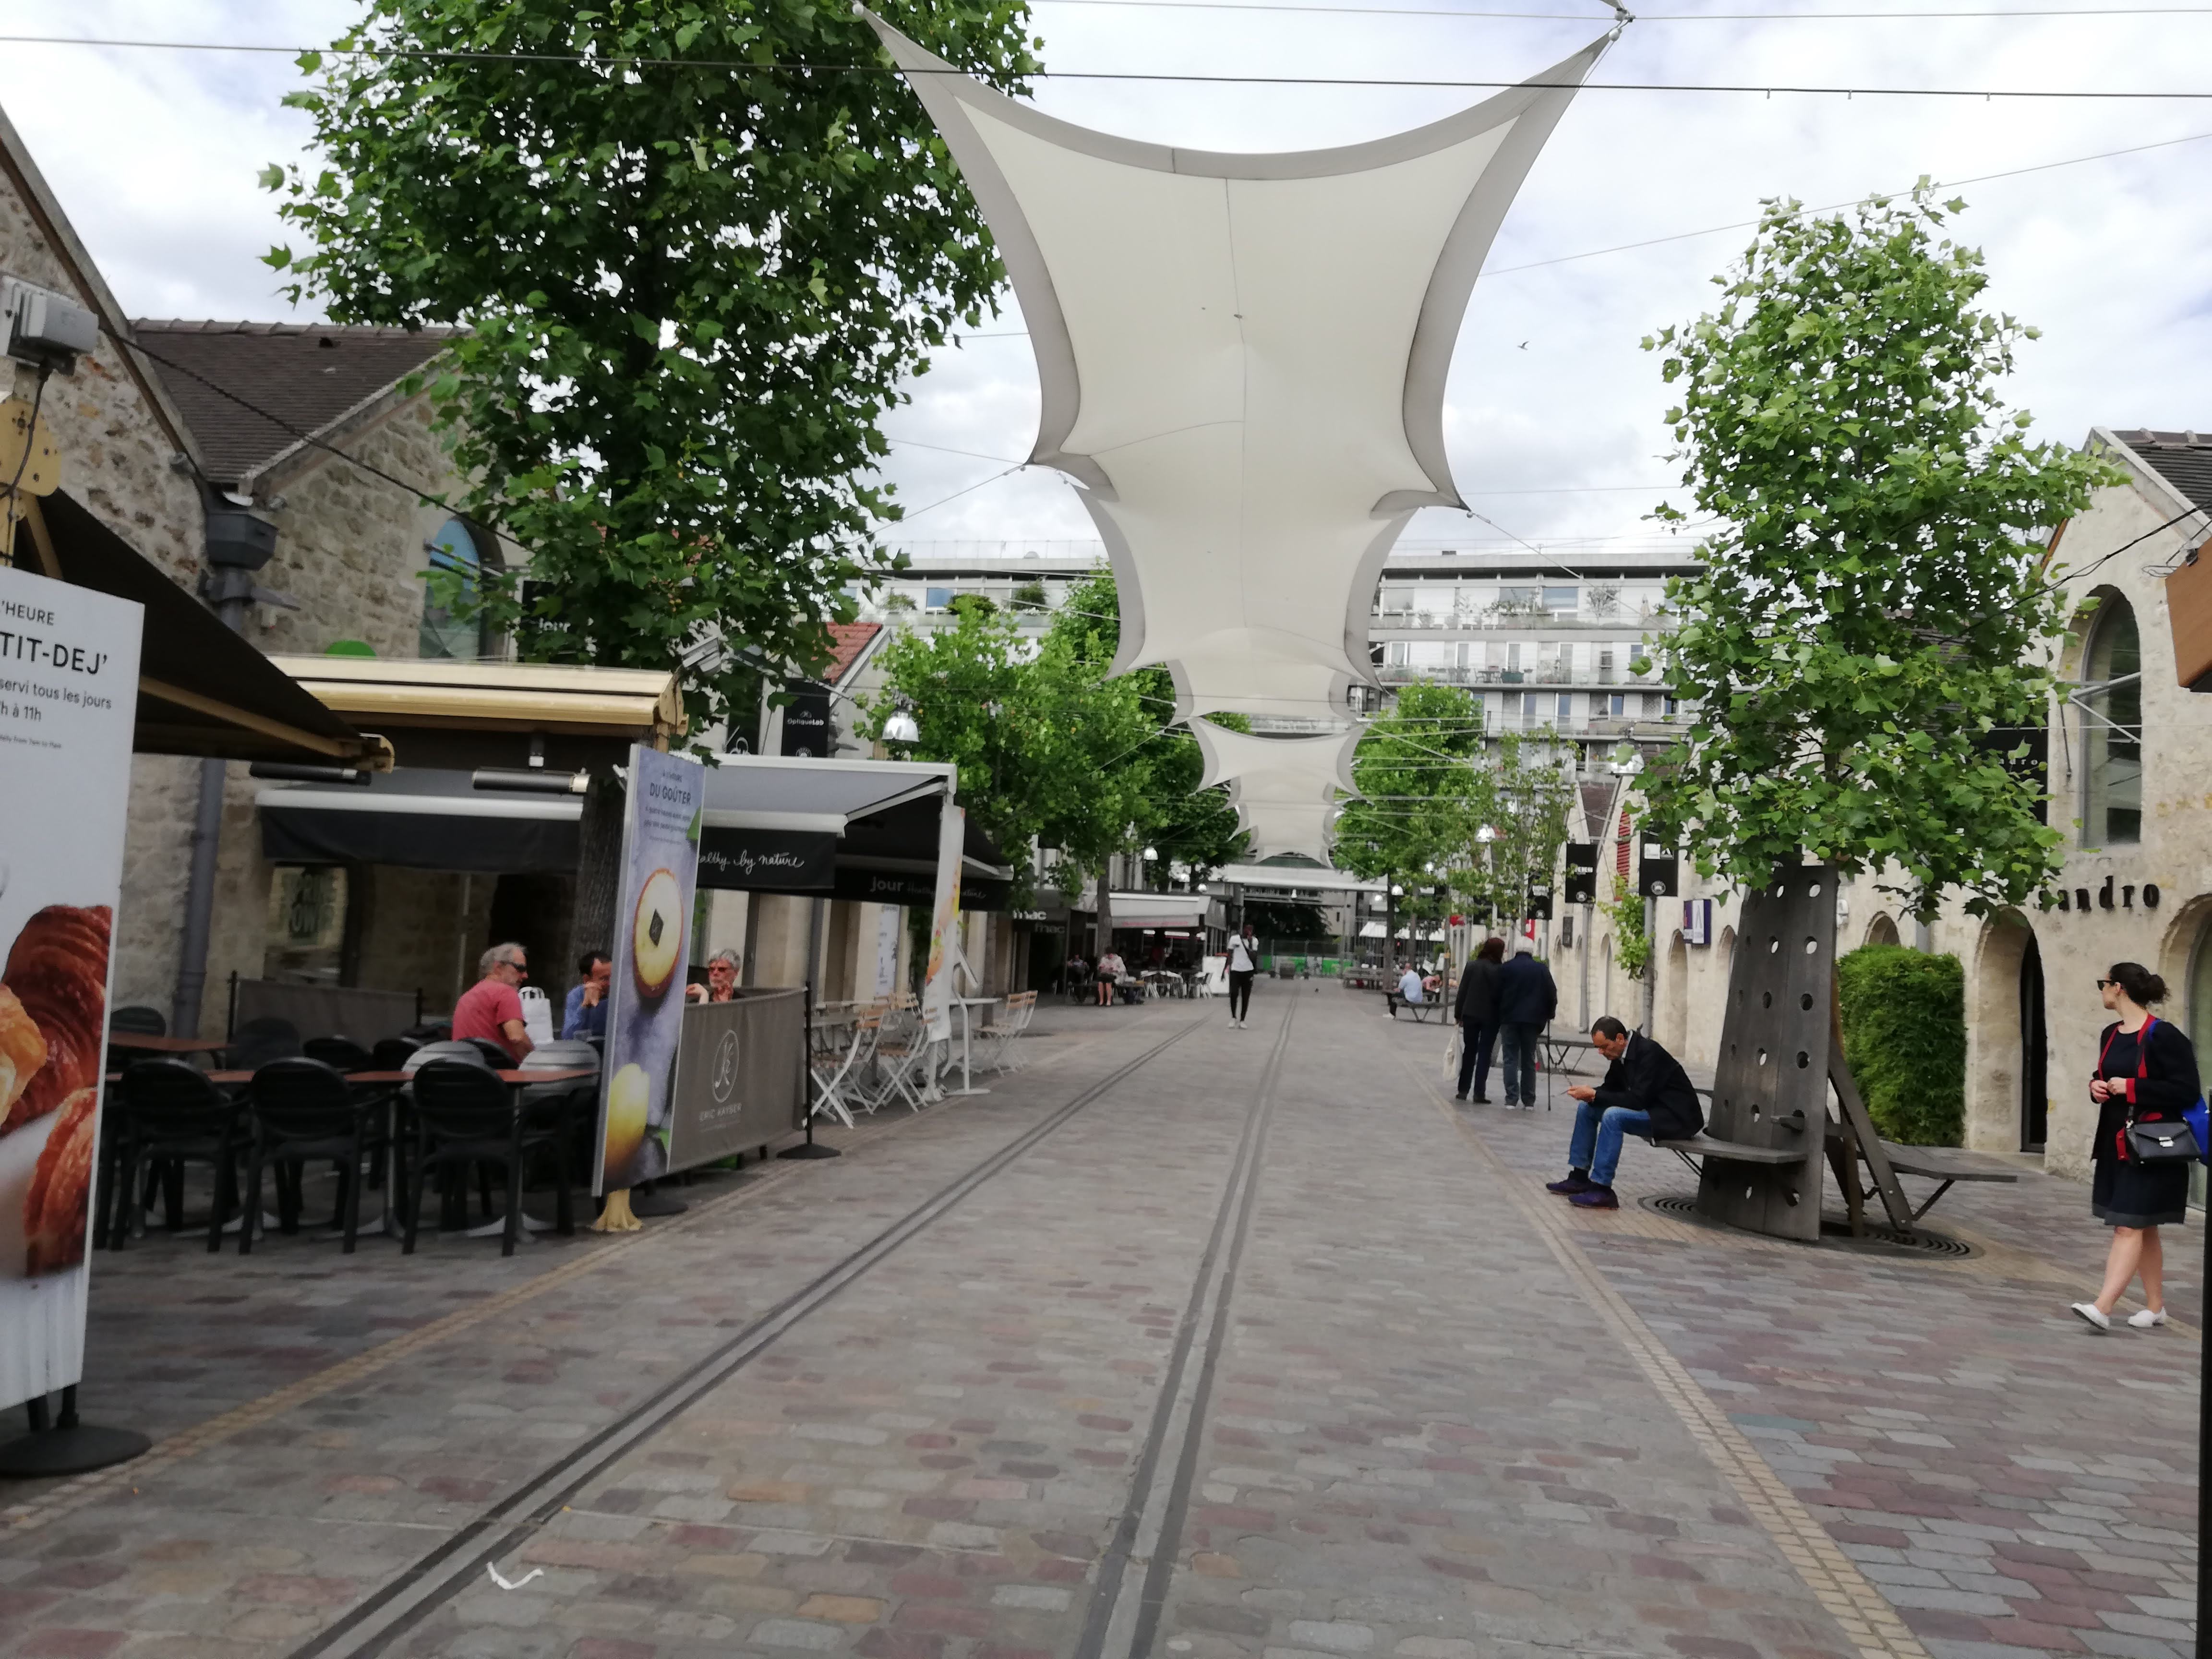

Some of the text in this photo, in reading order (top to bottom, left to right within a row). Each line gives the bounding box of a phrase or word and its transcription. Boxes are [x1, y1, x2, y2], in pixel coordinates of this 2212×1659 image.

[33, 683, 60, 700] tous
[63, 687, 80, 704] les
[82, 690, 112, 710] jours
[24, 706, 41, 722] 11h
[649, 782, 691, 805] DU GOÛTER
[734, 849, 756, 875] by
[759, 852, 805, 868] nature
